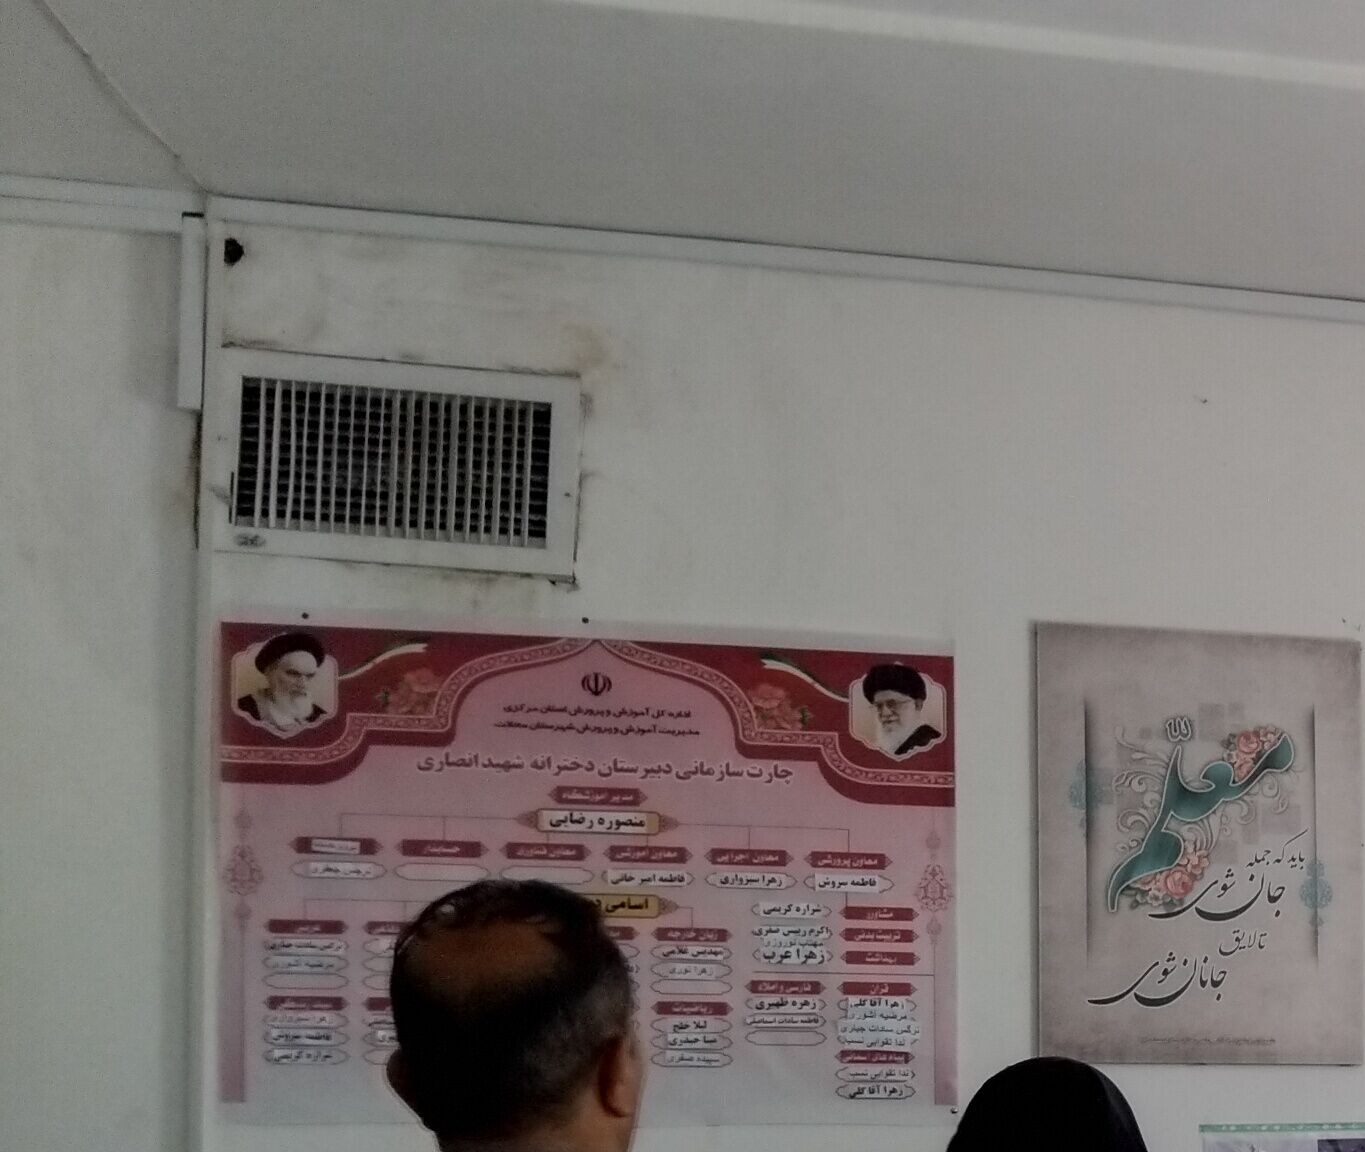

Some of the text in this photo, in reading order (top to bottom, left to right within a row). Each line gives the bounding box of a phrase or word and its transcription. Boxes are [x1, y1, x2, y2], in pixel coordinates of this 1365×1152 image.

[416, 751, 794, 785] چارت سازمانی دبیرستان دخترانه شهید انصاری
[600, 815, 647, 831] منصوره
[1107, 732, 1295, 914] معلم
[1247, 849, 1272, 867] جمله
[604, 897, 650, 913] اسامی
[1194, 873, 1286, 922] جان
[1133, 955, 1228, 1008] جانان
